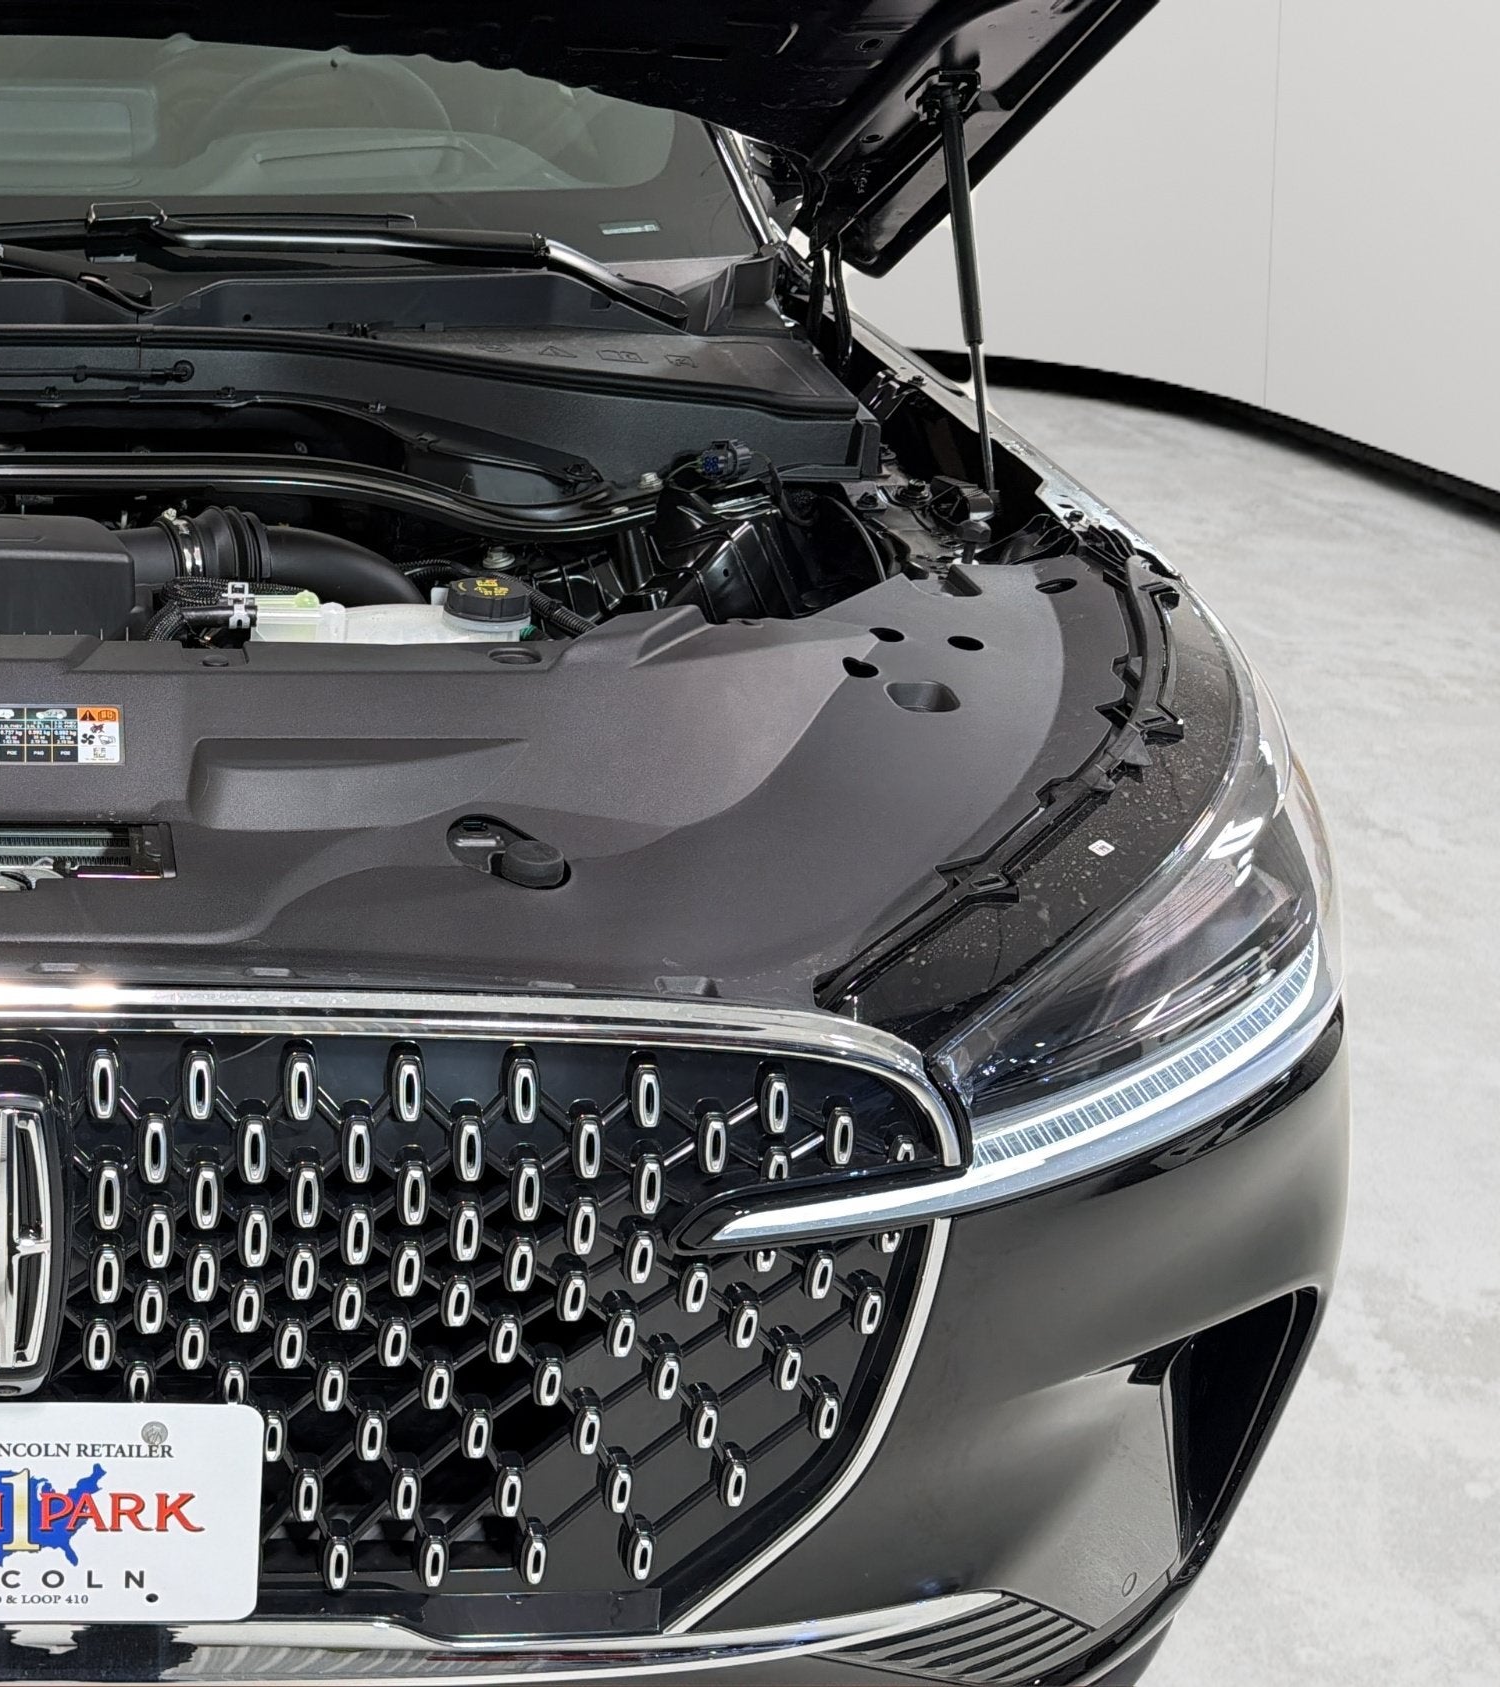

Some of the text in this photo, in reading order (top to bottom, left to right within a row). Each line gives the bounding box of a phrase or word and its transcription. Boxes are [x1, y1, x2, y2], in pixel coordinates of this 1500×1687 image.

[76, 1443, 173, 1458] RETAILER
[40, 1492, 205, 1532] PARK
[6, 1595, 18, 1604] &
[22, 1595, 62, 1604] LOOP
[65, 1595, 89, 1604] 410
